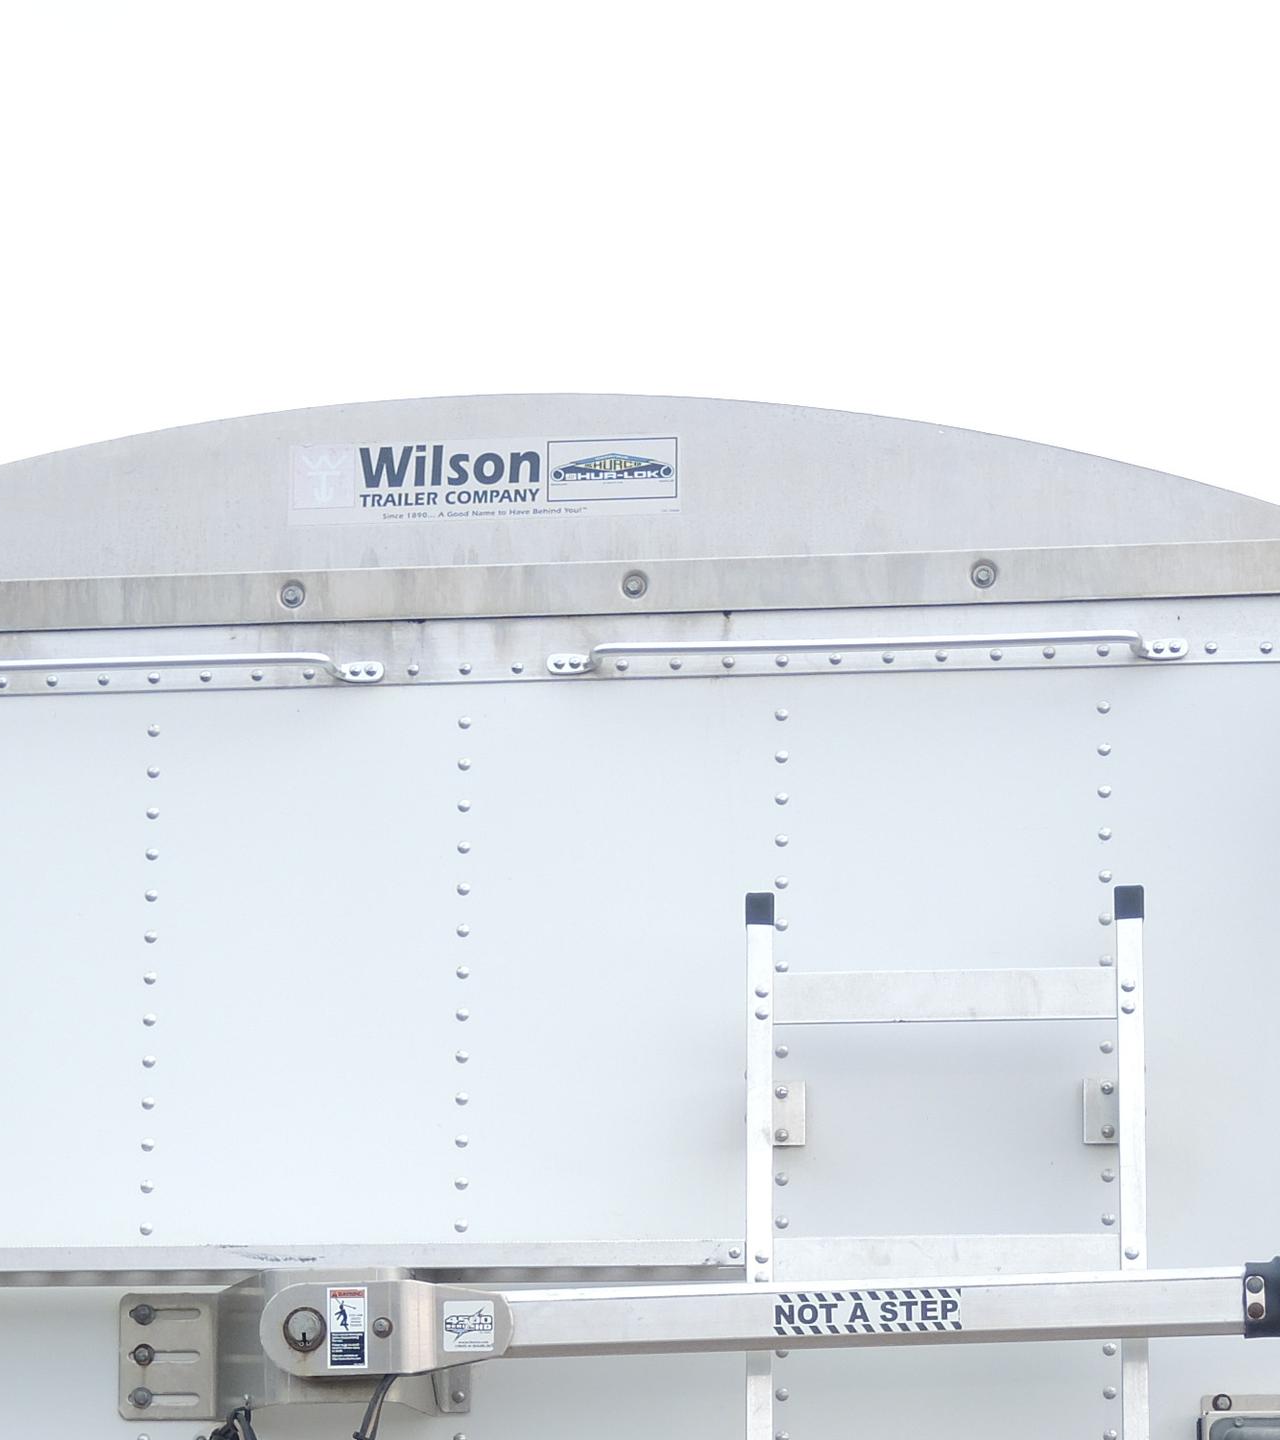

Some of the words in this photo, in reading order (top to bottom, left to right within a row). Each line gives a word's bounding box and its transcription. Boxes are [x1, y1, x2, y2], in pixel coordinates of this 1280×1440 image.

[359, 445, 540, 488] Wilson
[566, 470, 660, 480] SHUR-LOK
[360, 492, 438, 508] TRAILER
[445, 488, 540, 505] COMPANY
[444, 1314, 492, 1324] 4500
[775, 1303, 838, 1325] NOT
[848, 1302, 870, 1323] A
[880, 1300, 959, 1322] STEP
